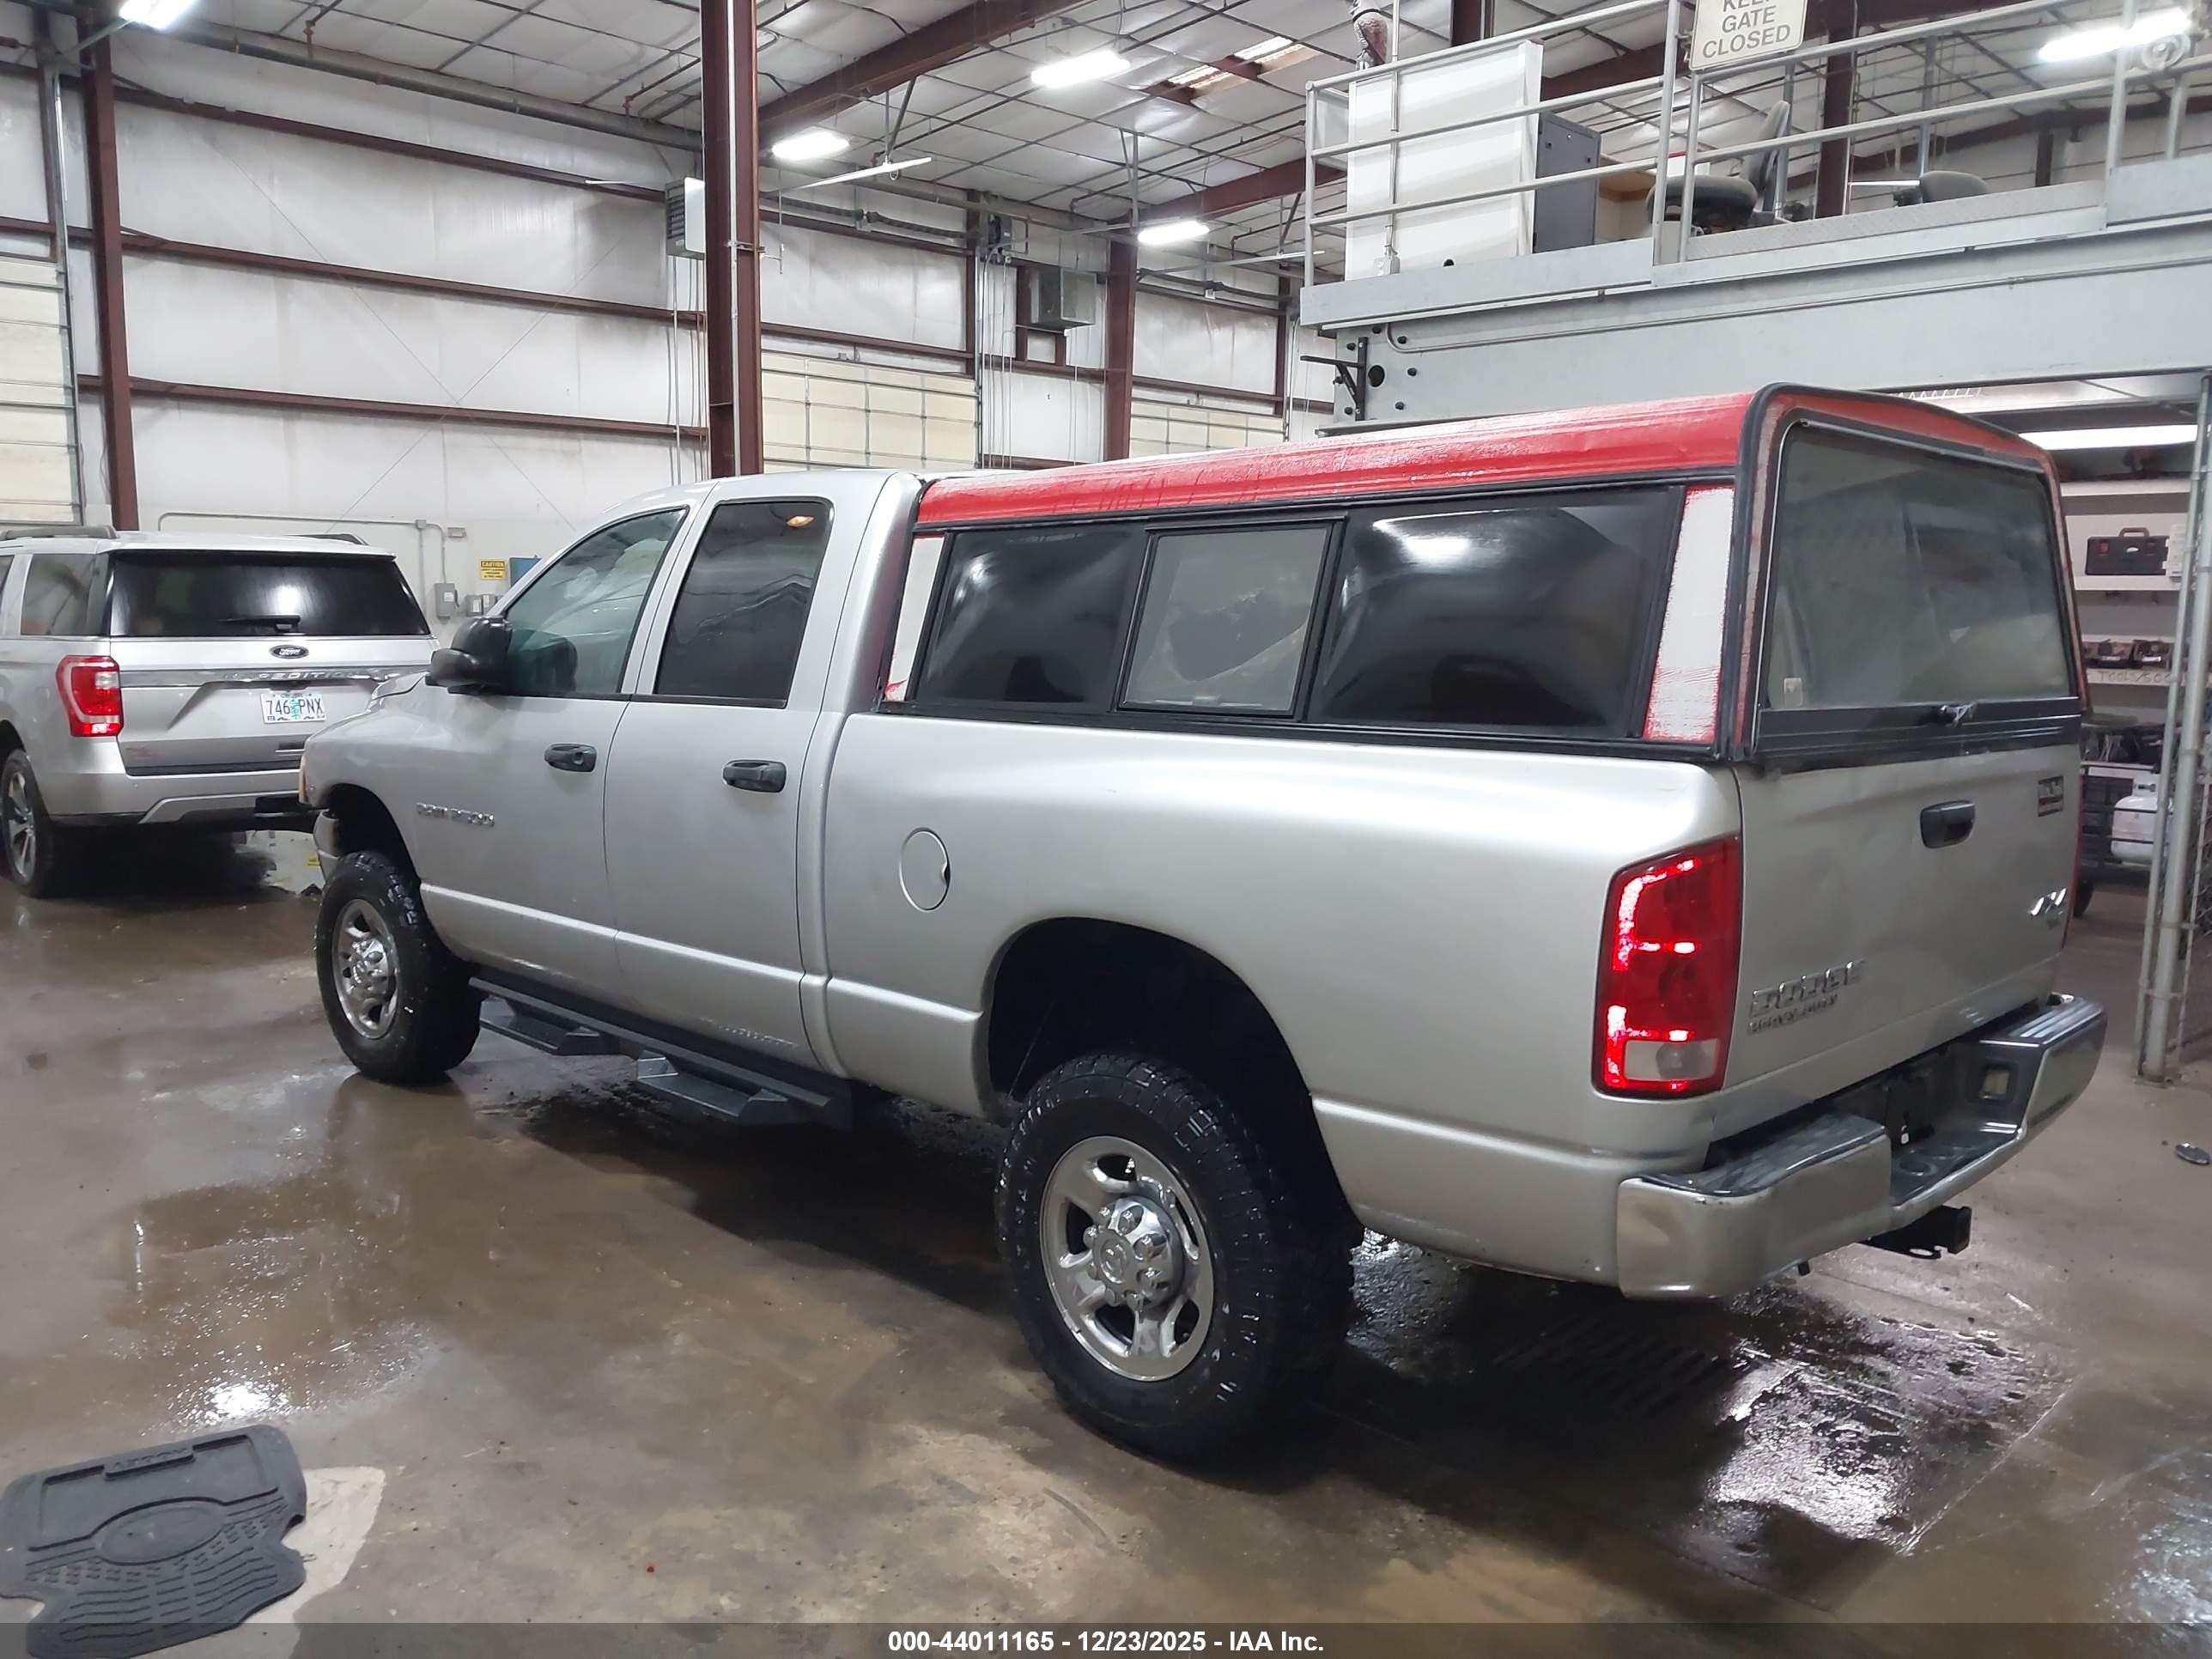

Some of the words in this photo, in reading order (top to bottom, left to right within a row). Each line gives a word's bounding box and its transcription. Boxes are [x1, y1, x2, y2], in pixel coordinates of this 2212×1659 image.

[1722, 5, 1777, 33] GATE
[1702, 24, 1791, 58] CLOSED
[264, 698, 291, 715] 746
[297, 697, 325, 714] PNX
